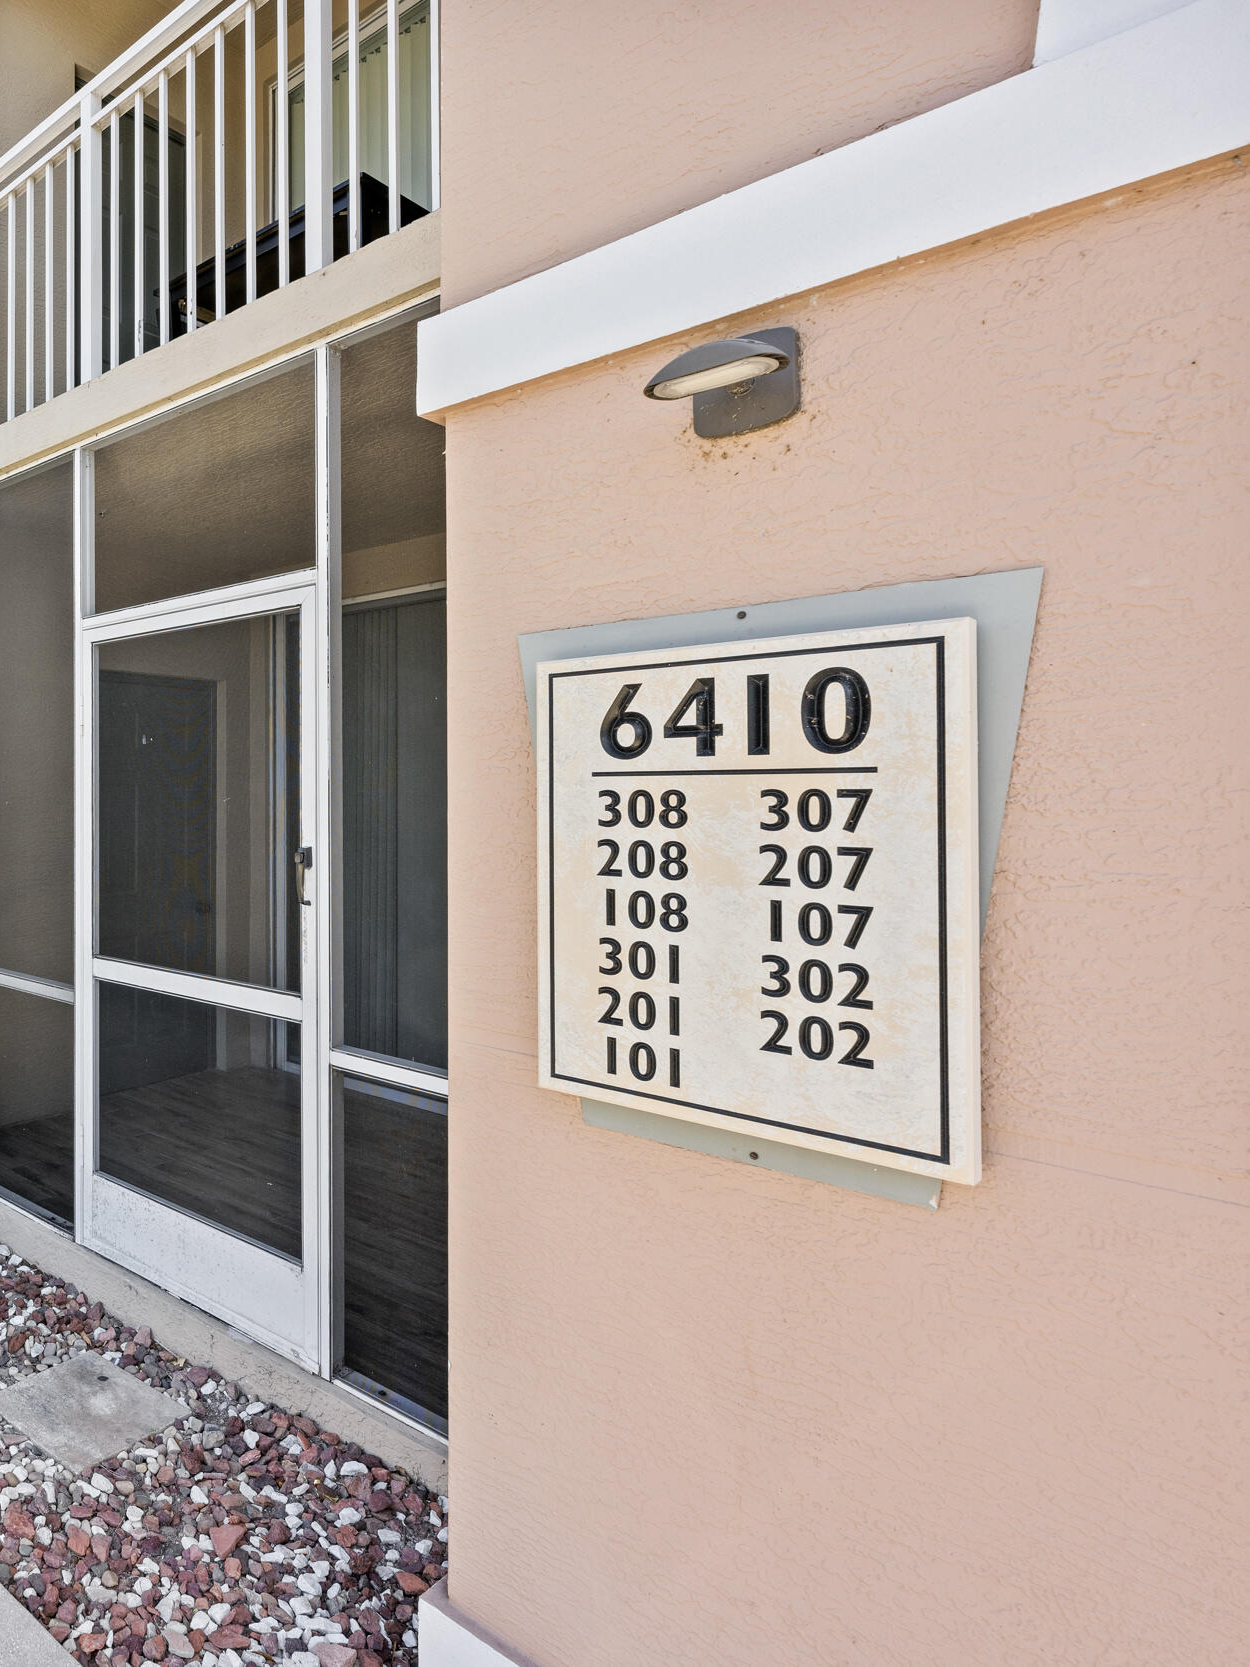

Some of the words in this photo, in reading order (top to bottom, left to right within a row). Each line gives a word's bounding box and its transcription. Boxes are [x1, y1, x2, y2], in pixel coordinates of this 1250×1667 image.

[599, 666, 872, 760] 6410
[598, 789, 688, 829] 308
[760, 788, 873, 834] 307
[596, 838, 689, 881] 208
[758, 843, 874, 892] 207
[605, 888, 689, 933] 108
[770, 899, 874, 950] 107
[598, 937, 680, 985] 301
[761, 954, 874, 1011] 302
[597, 986, 680, 1037] 201
[606, 1037, 681, 1088] 101
[759, 1009, 874, 1070] 202
